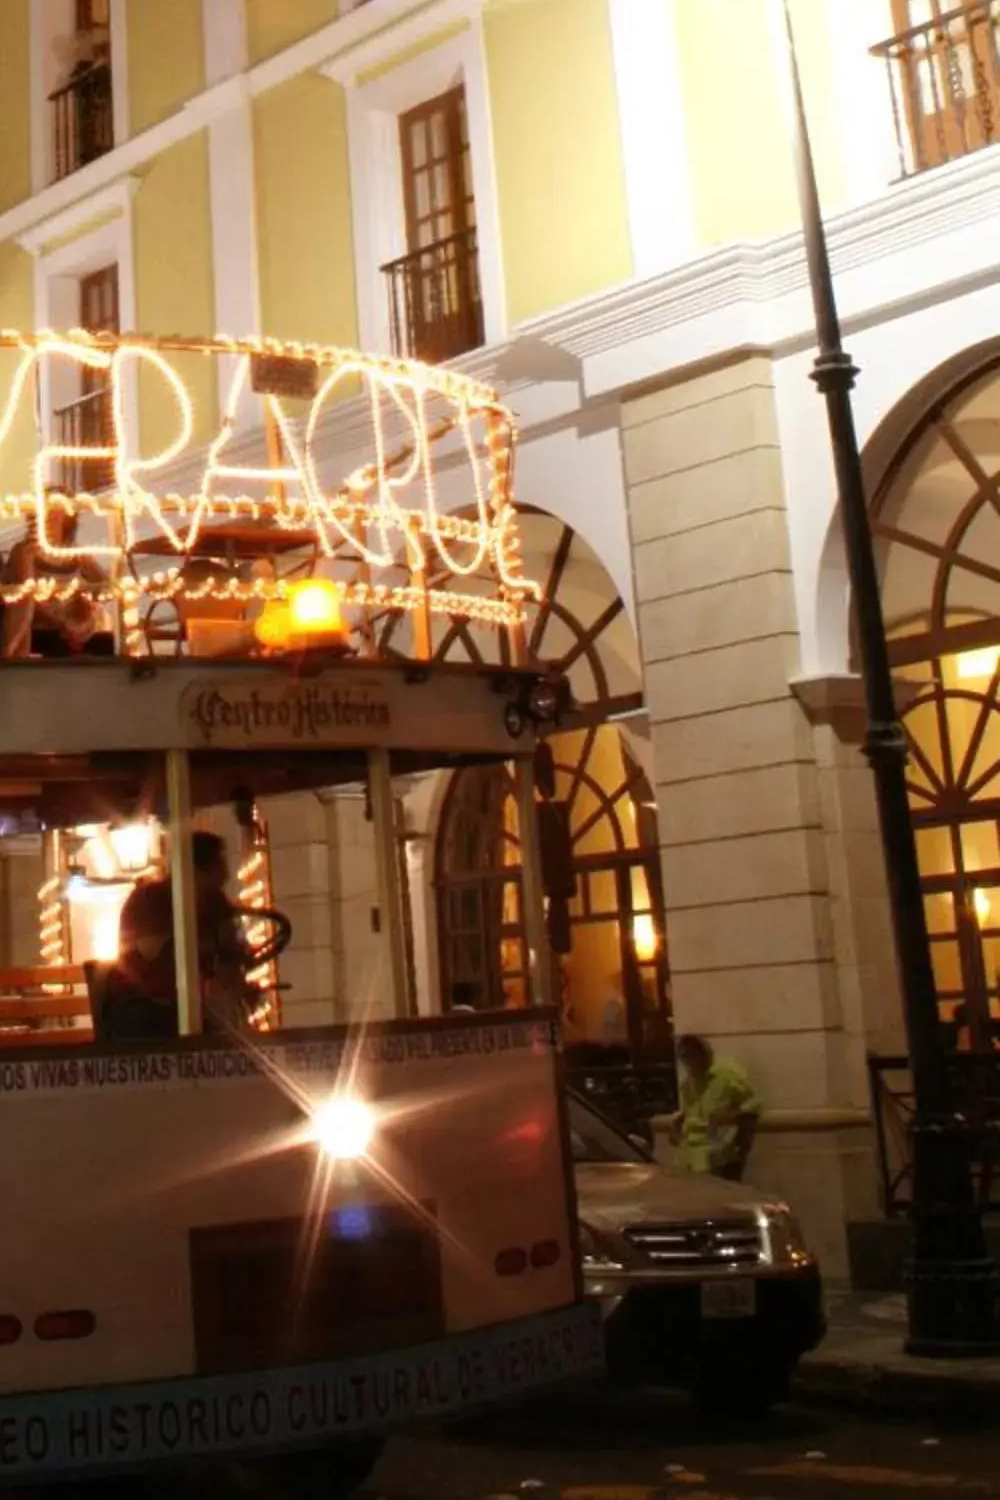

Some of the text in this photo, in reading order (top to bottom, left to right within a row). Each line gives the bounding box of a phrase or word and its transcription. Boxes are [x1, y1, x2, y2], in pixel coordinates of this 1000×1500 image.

[189, 688, 293, 742] Centro
[32, 1060, 79, 1088] VIVAS
[84, 1055, 171, 1085] NUESTRAS
[67, 1389, 271, 1458] HISTORICO
[287, 1360, 449, 1430] CULTURAL
[457, 1350, 484, 1398] DE
